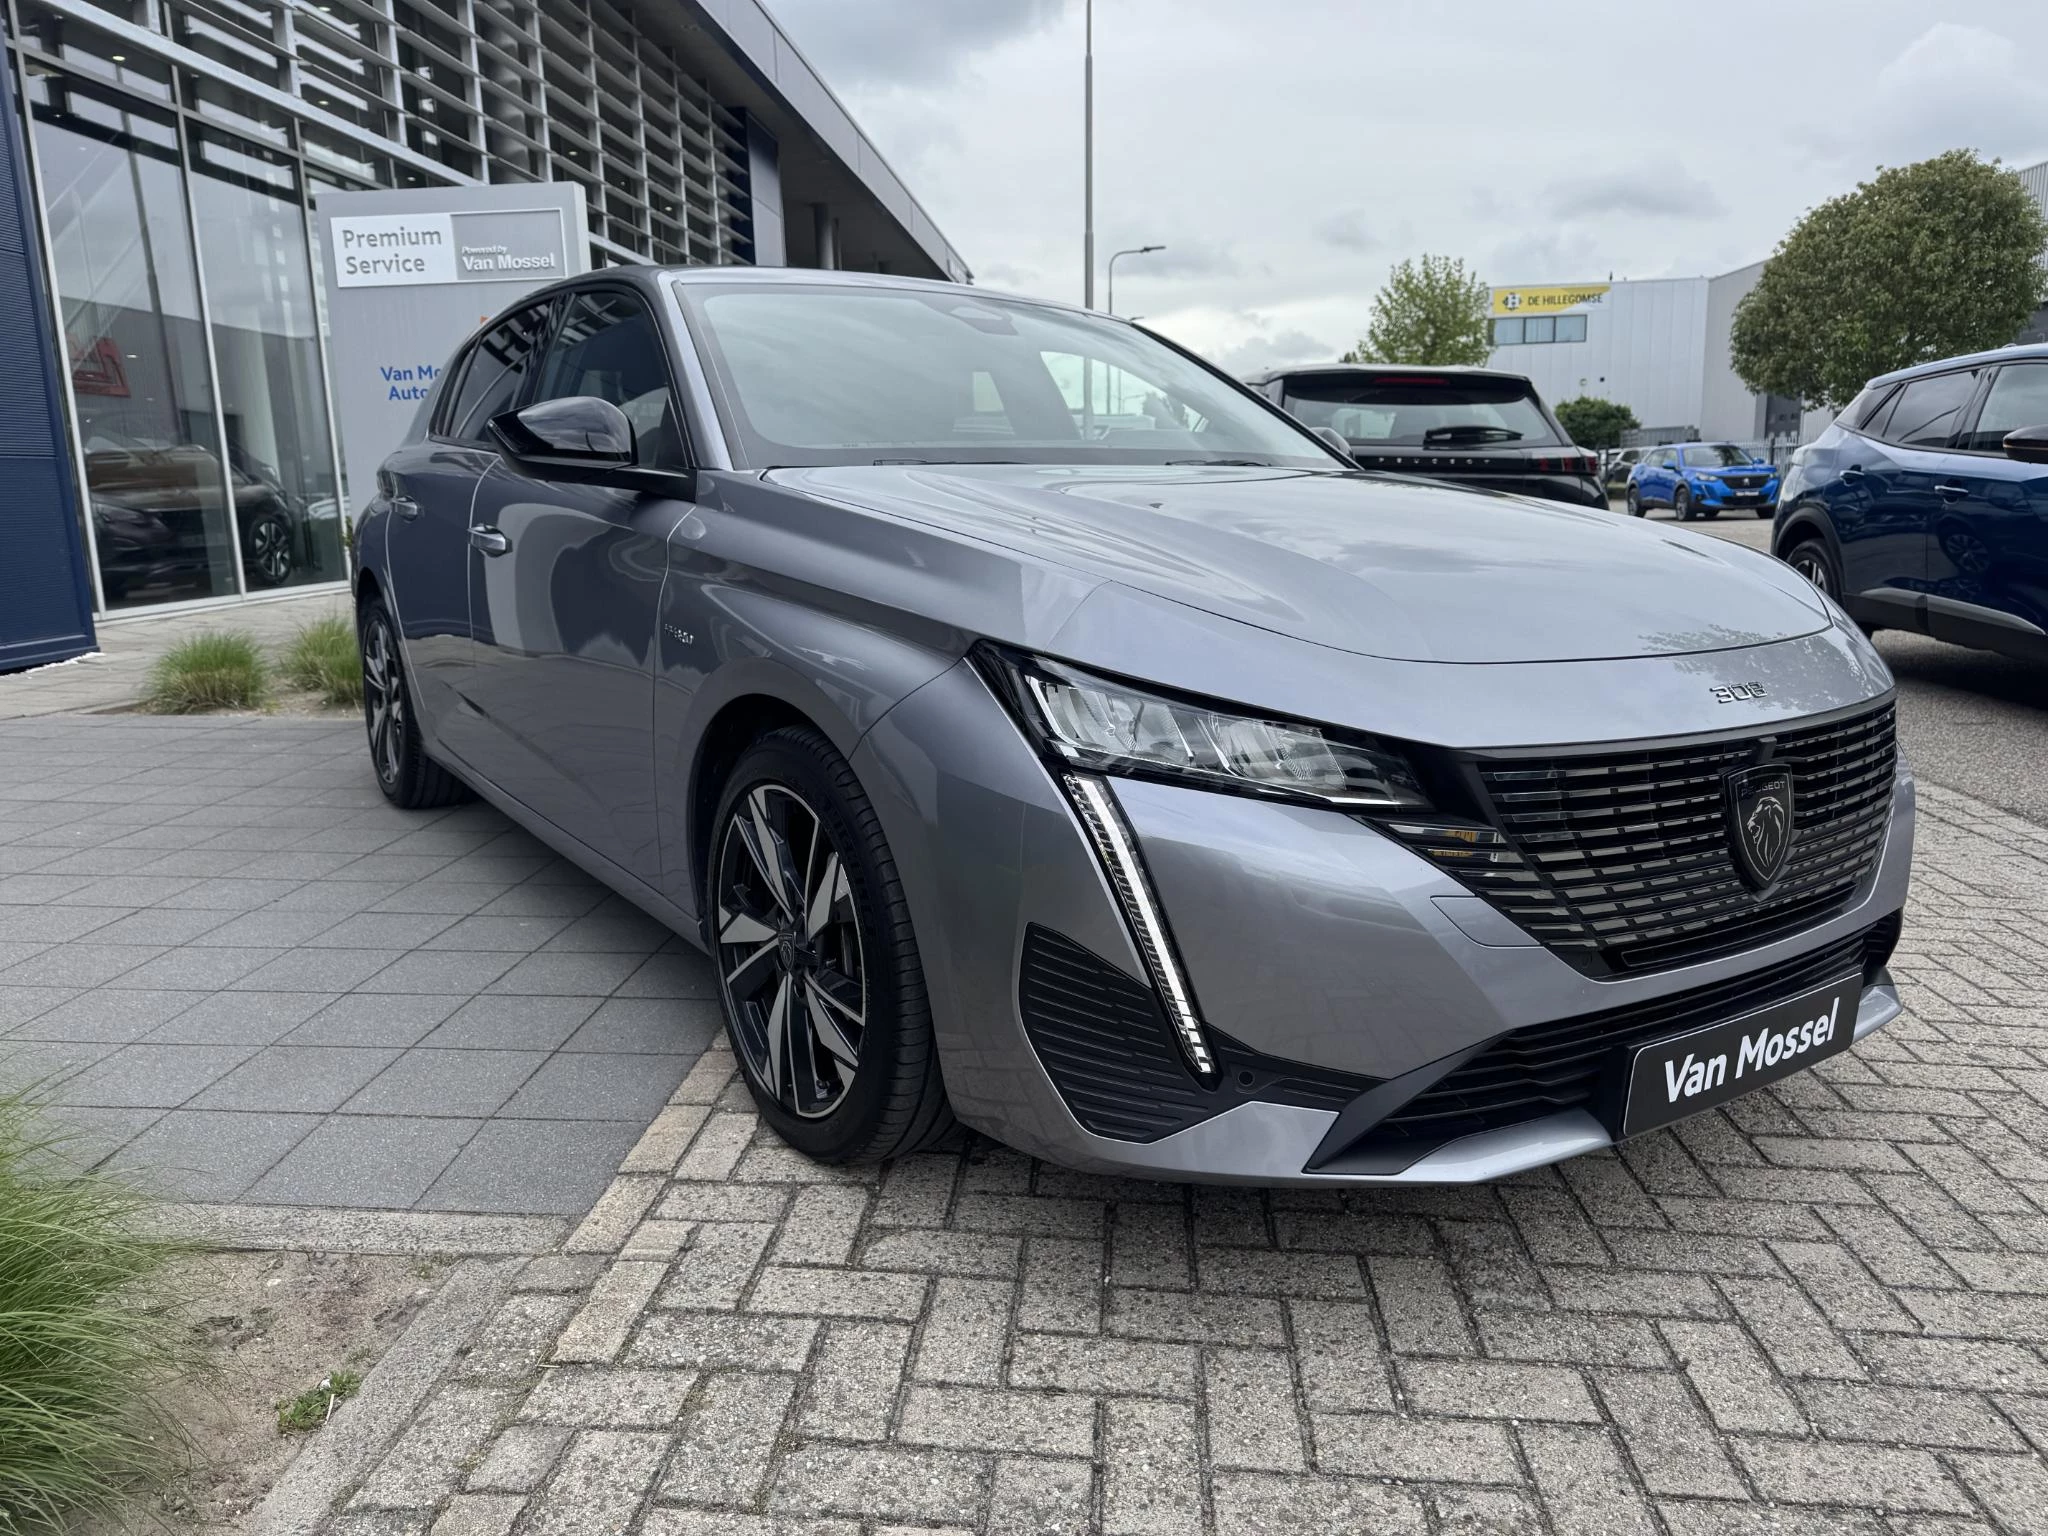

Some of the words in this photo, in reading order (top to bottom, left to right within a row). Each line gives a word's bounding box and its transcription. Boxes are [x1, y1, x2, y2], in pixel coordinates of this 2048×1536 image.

[342, 226, 442, 249] Premium
[345, 253, 425, 275] Service
[462, 256, 494, 271] Van
[497, 252, 555, 269] Mossel
[1528, 296, 1540, 305] DE
[1542, 294, 1603, 305] HILLEGOMSE
[380, 366, 413, 381] Van
[1709, 681, 1768, 704] 308
[1741, 781, 1785, 797] PGEOT
[1664, 1053, 1727, 1103] Van
[1734, 996, 1840, 1079] Mossel
